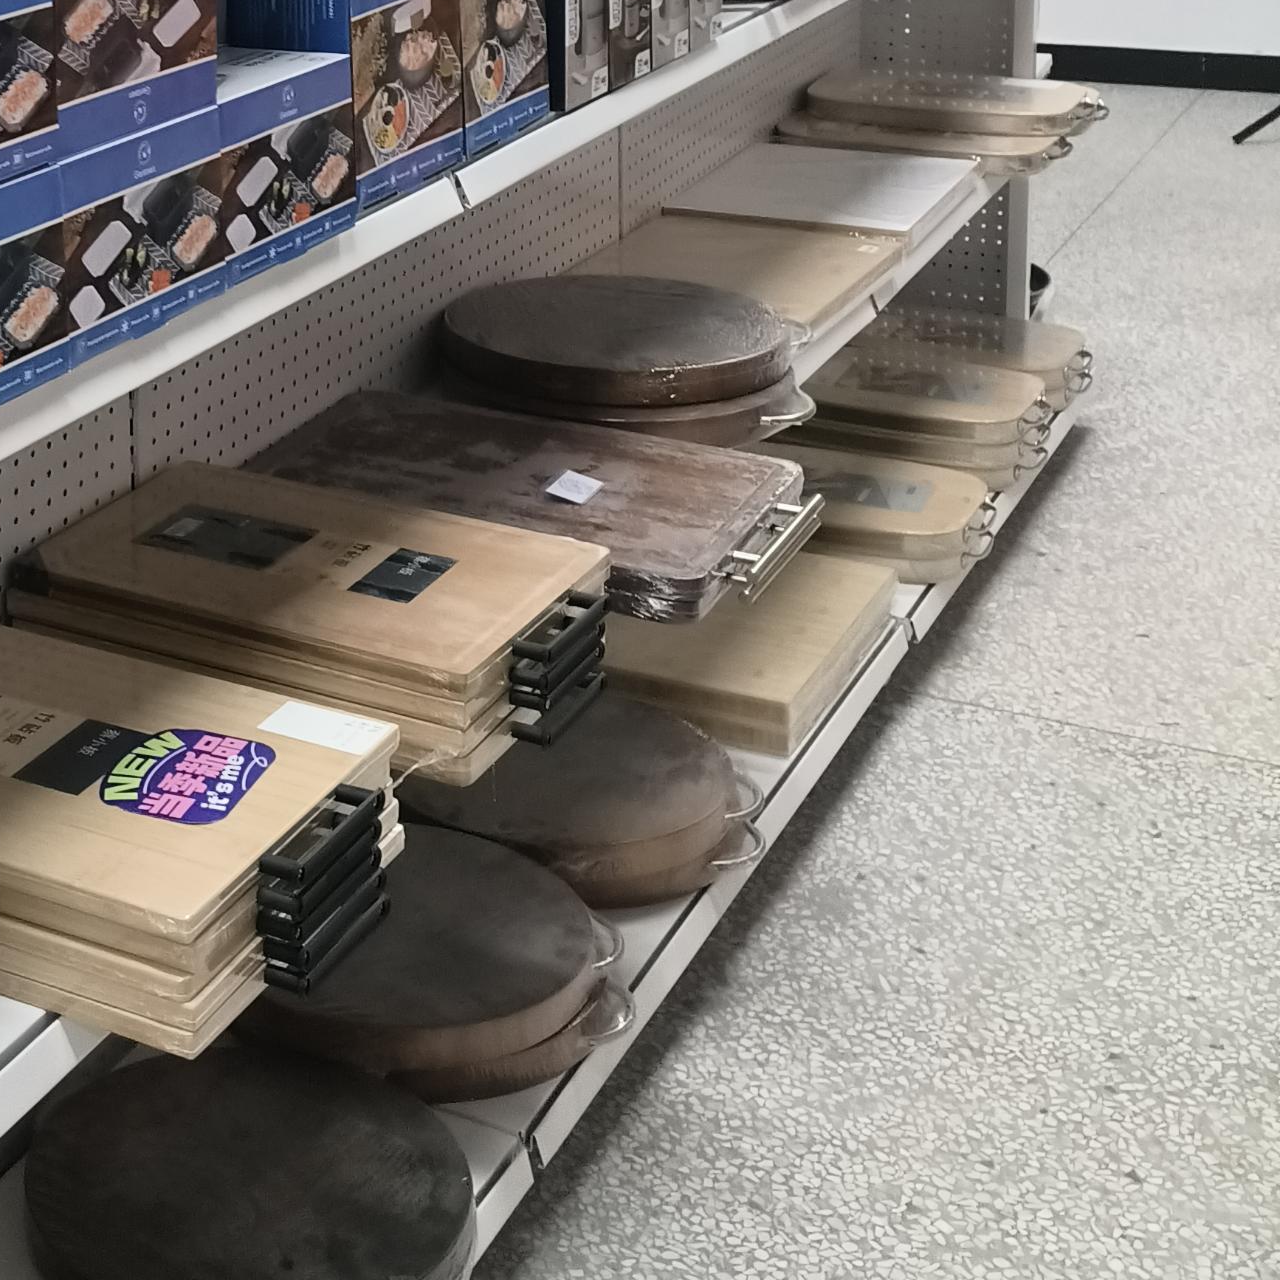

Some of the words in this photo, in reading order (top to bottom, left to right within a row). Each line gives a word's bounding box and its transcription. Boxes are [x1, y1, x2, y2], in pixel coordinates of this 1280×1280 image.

[103, 731, 186, 801] NEW
[138, 734, 249, 819] 当季新品
[200, 781, 235, 811] it's
[220, 754, 245, 782] me
